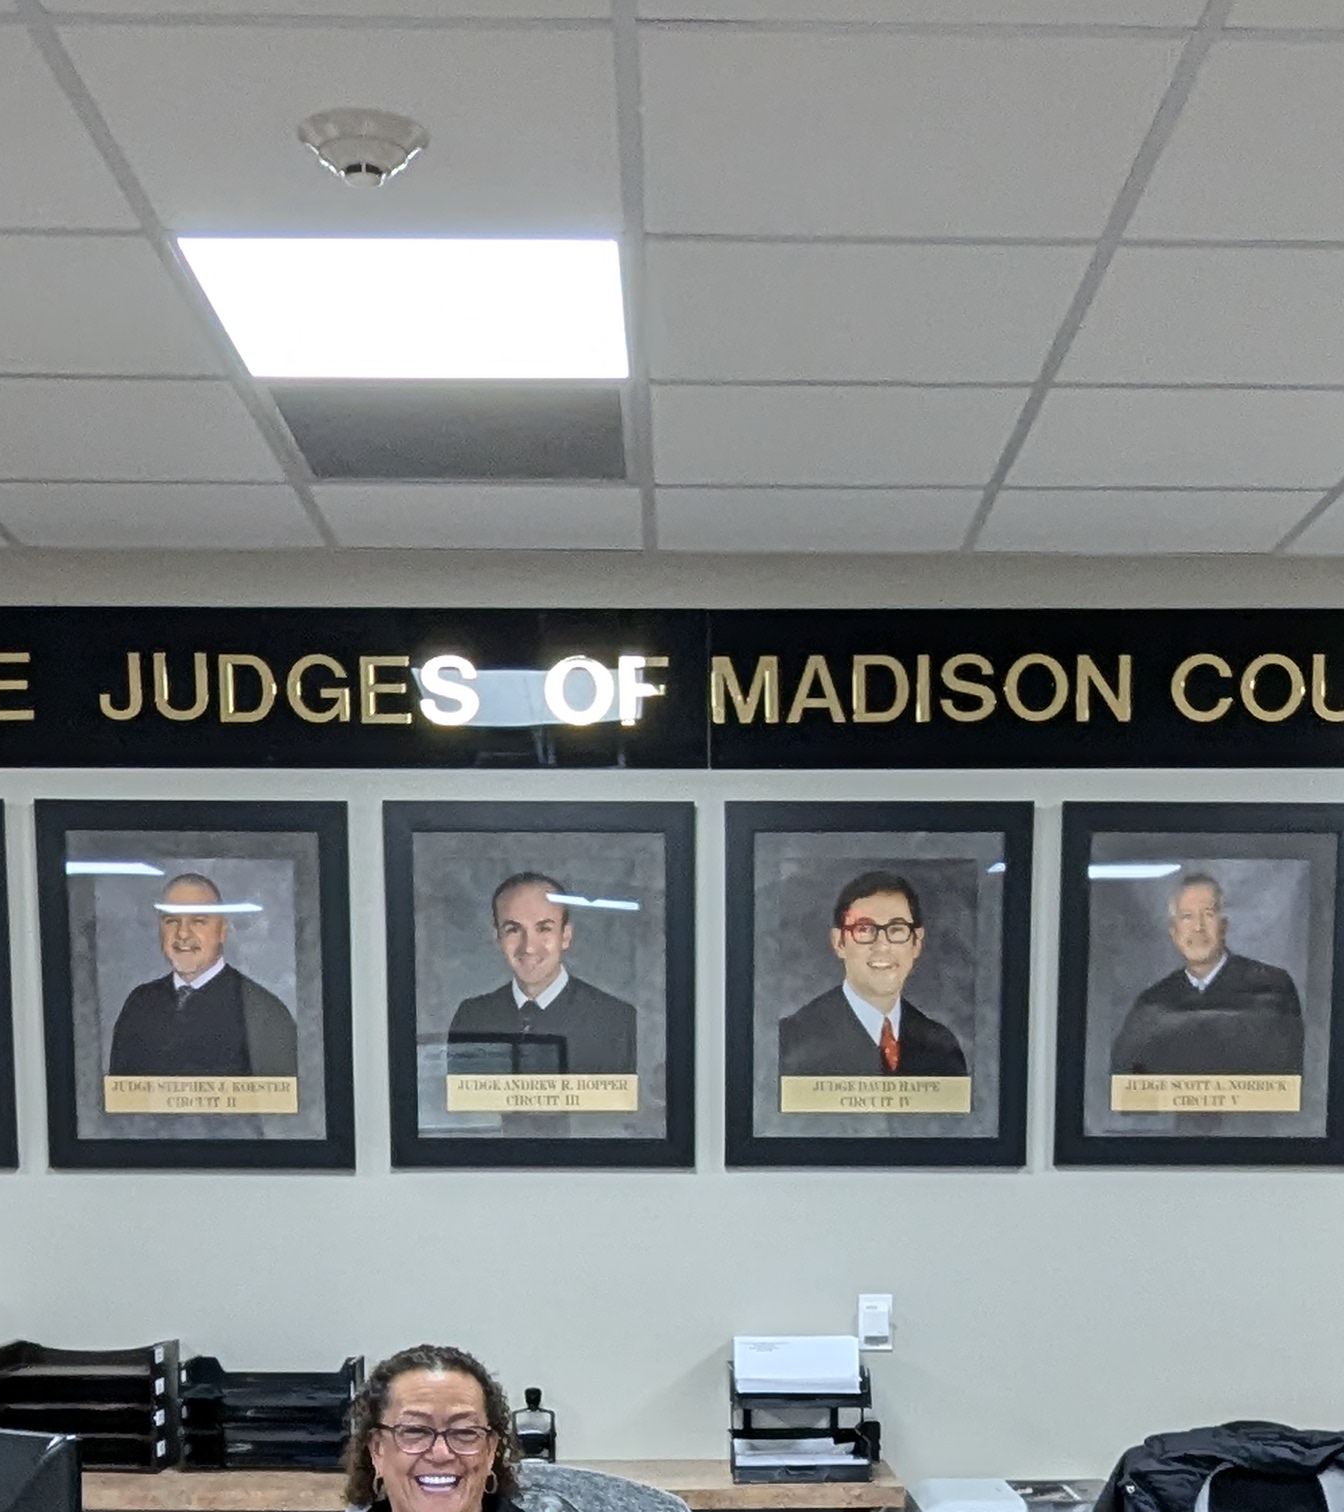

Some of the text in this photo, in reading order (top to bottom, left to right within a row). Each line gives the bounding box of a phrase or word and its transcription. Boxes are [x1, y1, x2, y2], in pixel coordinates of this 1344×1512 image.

[98, 651, 482, 728] JUDGES
[543, 653, 671, 728] OF
[710, 653, 1133, 726] MADISON
[112, 1081, 154, 1092] JUDGE
[157, 1081, 215, 1093] STEPHEN
[458, 1079, 501, 1091] JUDGE
[504, 1079, 557, 1091] ANDREW
[577, 1079, 628, 1091] HOPPER
[813, 1081, 855, 1092] JUDGE
[858, 1081, 896, 1092] DAVID
[1125, 1080, 1167, 1091] JUDGE
[1170, 1080, 1211, 1091] SCOTT
[167, 1096, 220, 1108] CIRCUIT
[506, 1095, 580, 1106] CIRCUIT III
[840, 1096, 894, 1108] CIRCUIT
[1173, 1095, 1226, 1107] CIRCUIT
